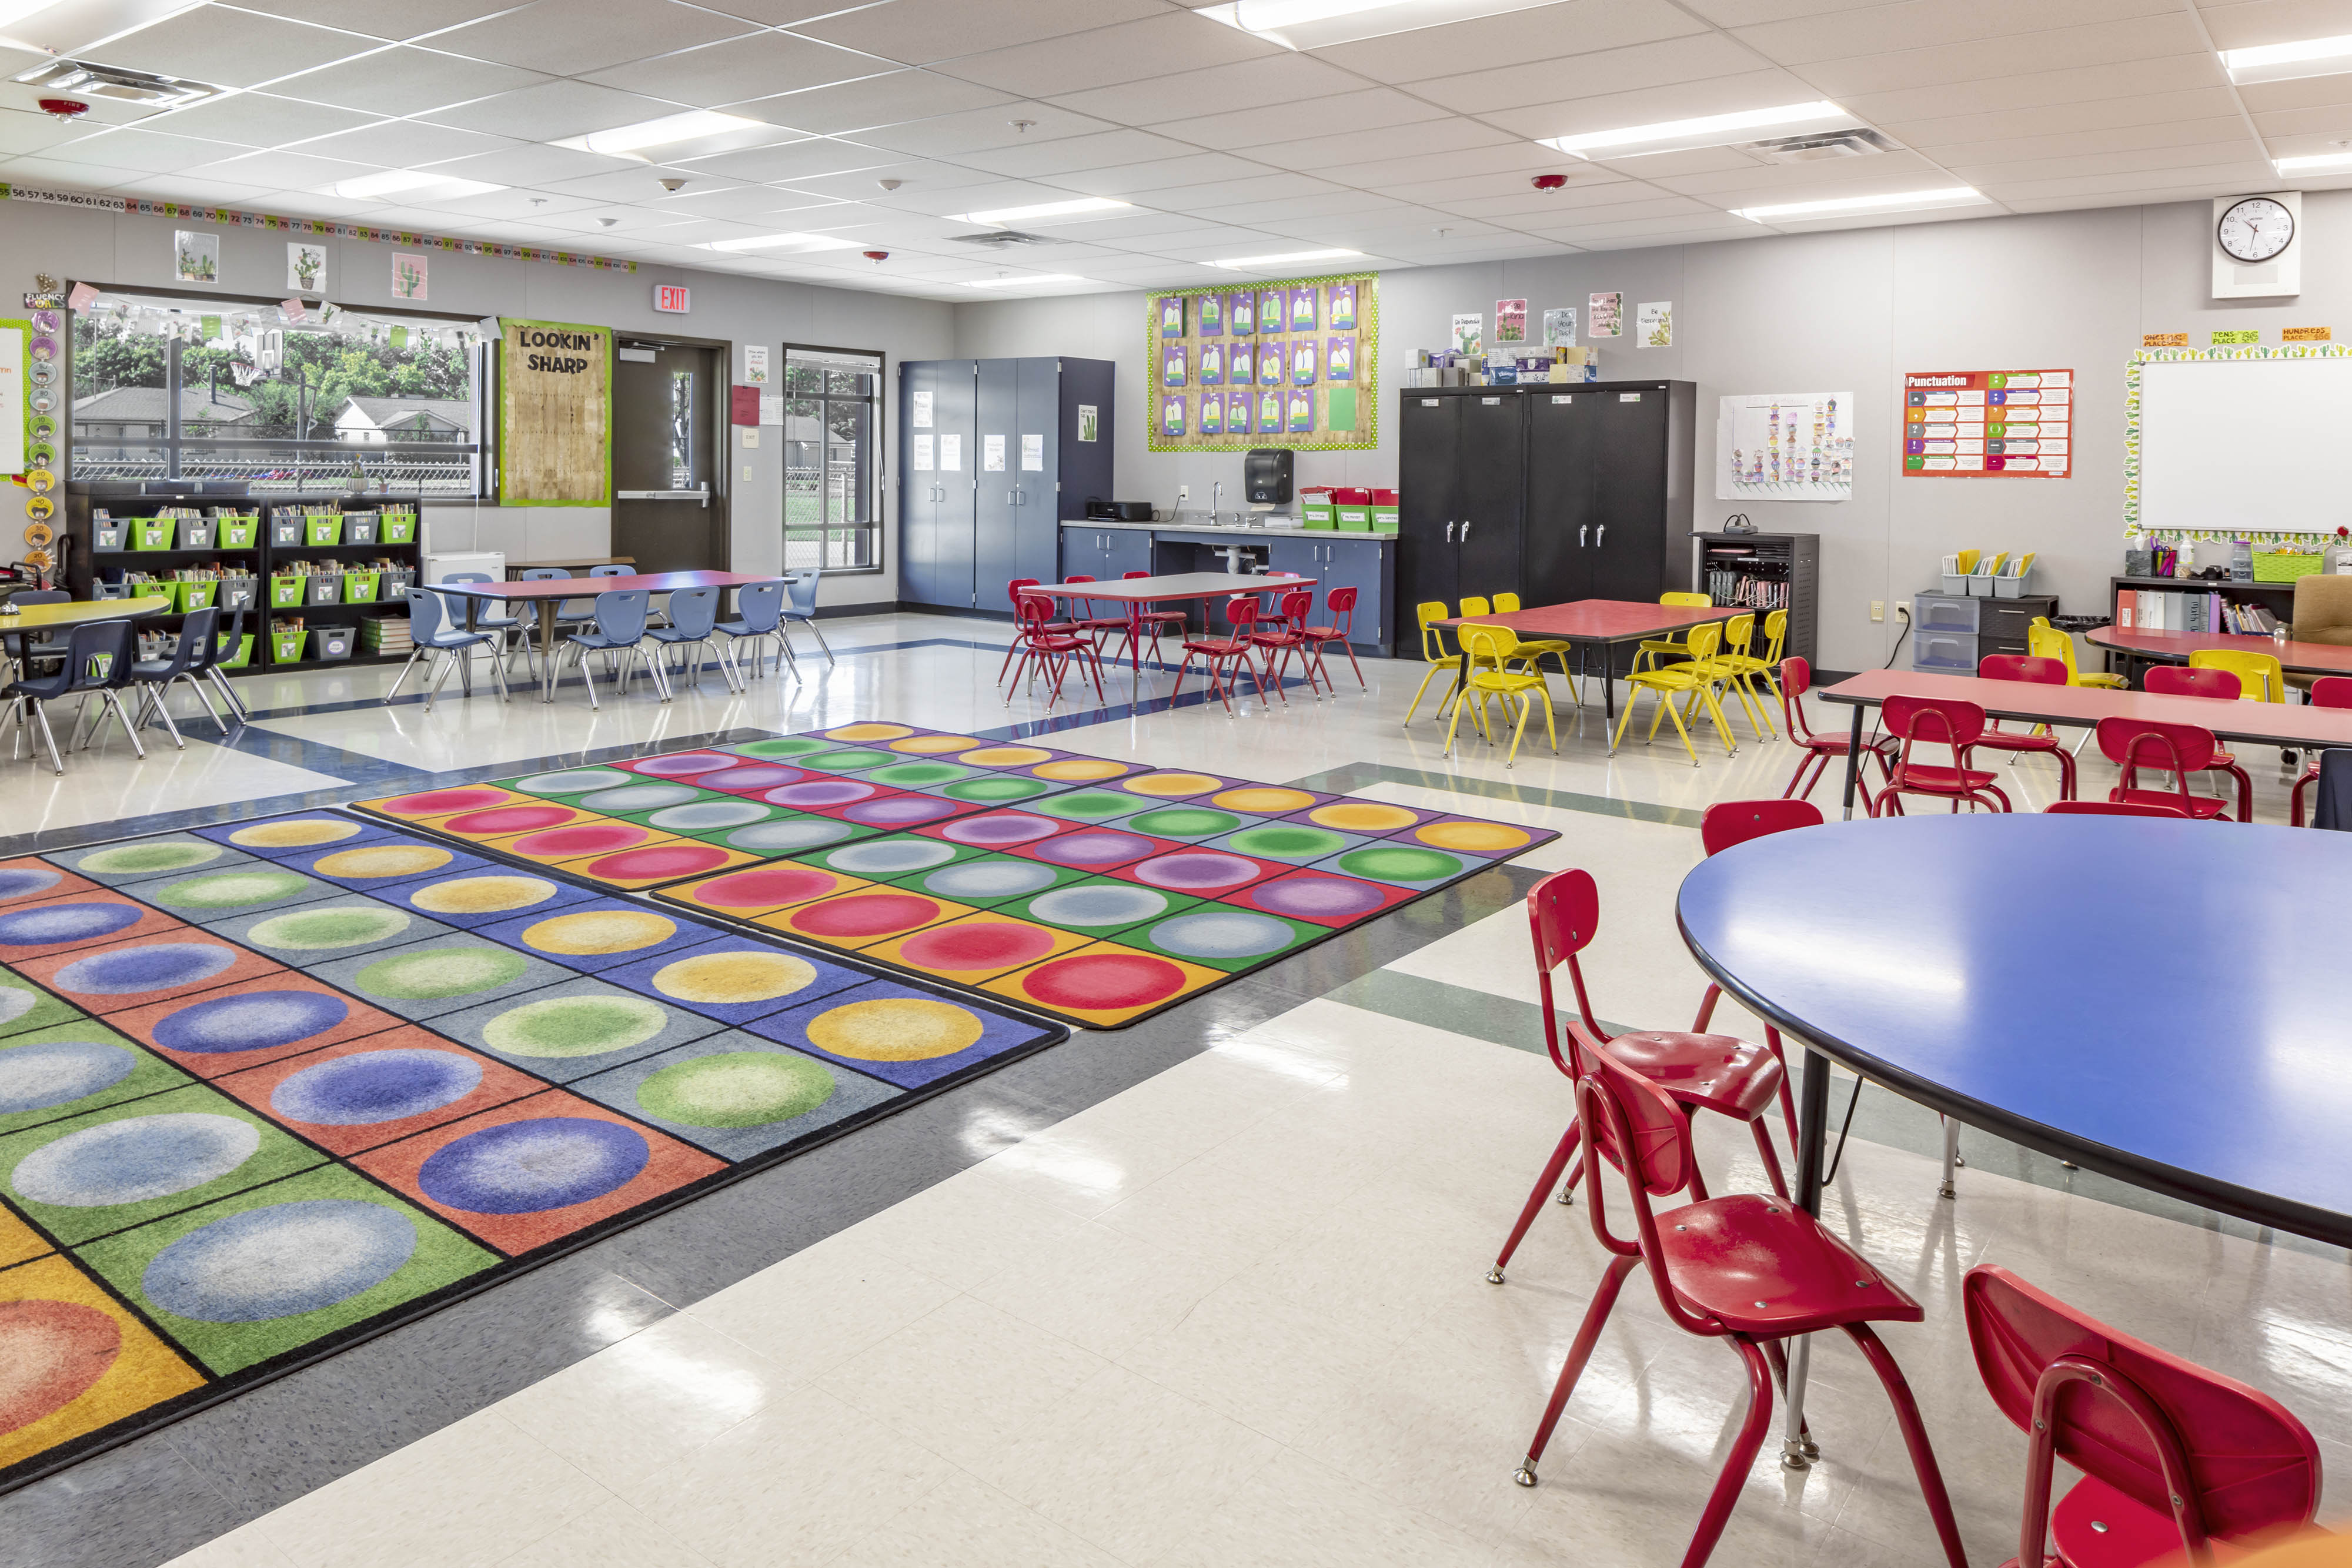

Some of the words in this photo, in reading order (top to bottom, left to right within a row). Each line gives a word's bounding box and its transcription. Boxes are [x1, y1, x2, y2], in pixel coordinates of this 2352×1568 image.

[12, 189, 25, 198] 56
[71, 195, 83, 203] 60
[180, 208, 189, 216] 68
[423, 238, 432, 246] 89
[28, 300, 66, 308] GOALS
[661, 286, 686, 310] EXIT
[520, 330, 599, 352] LOOKIN'
[527, 354, 589, 375] SHARP
[1908, 375, 1967, 387] Punctuation
[2190, 601, 2199, 621] Math
